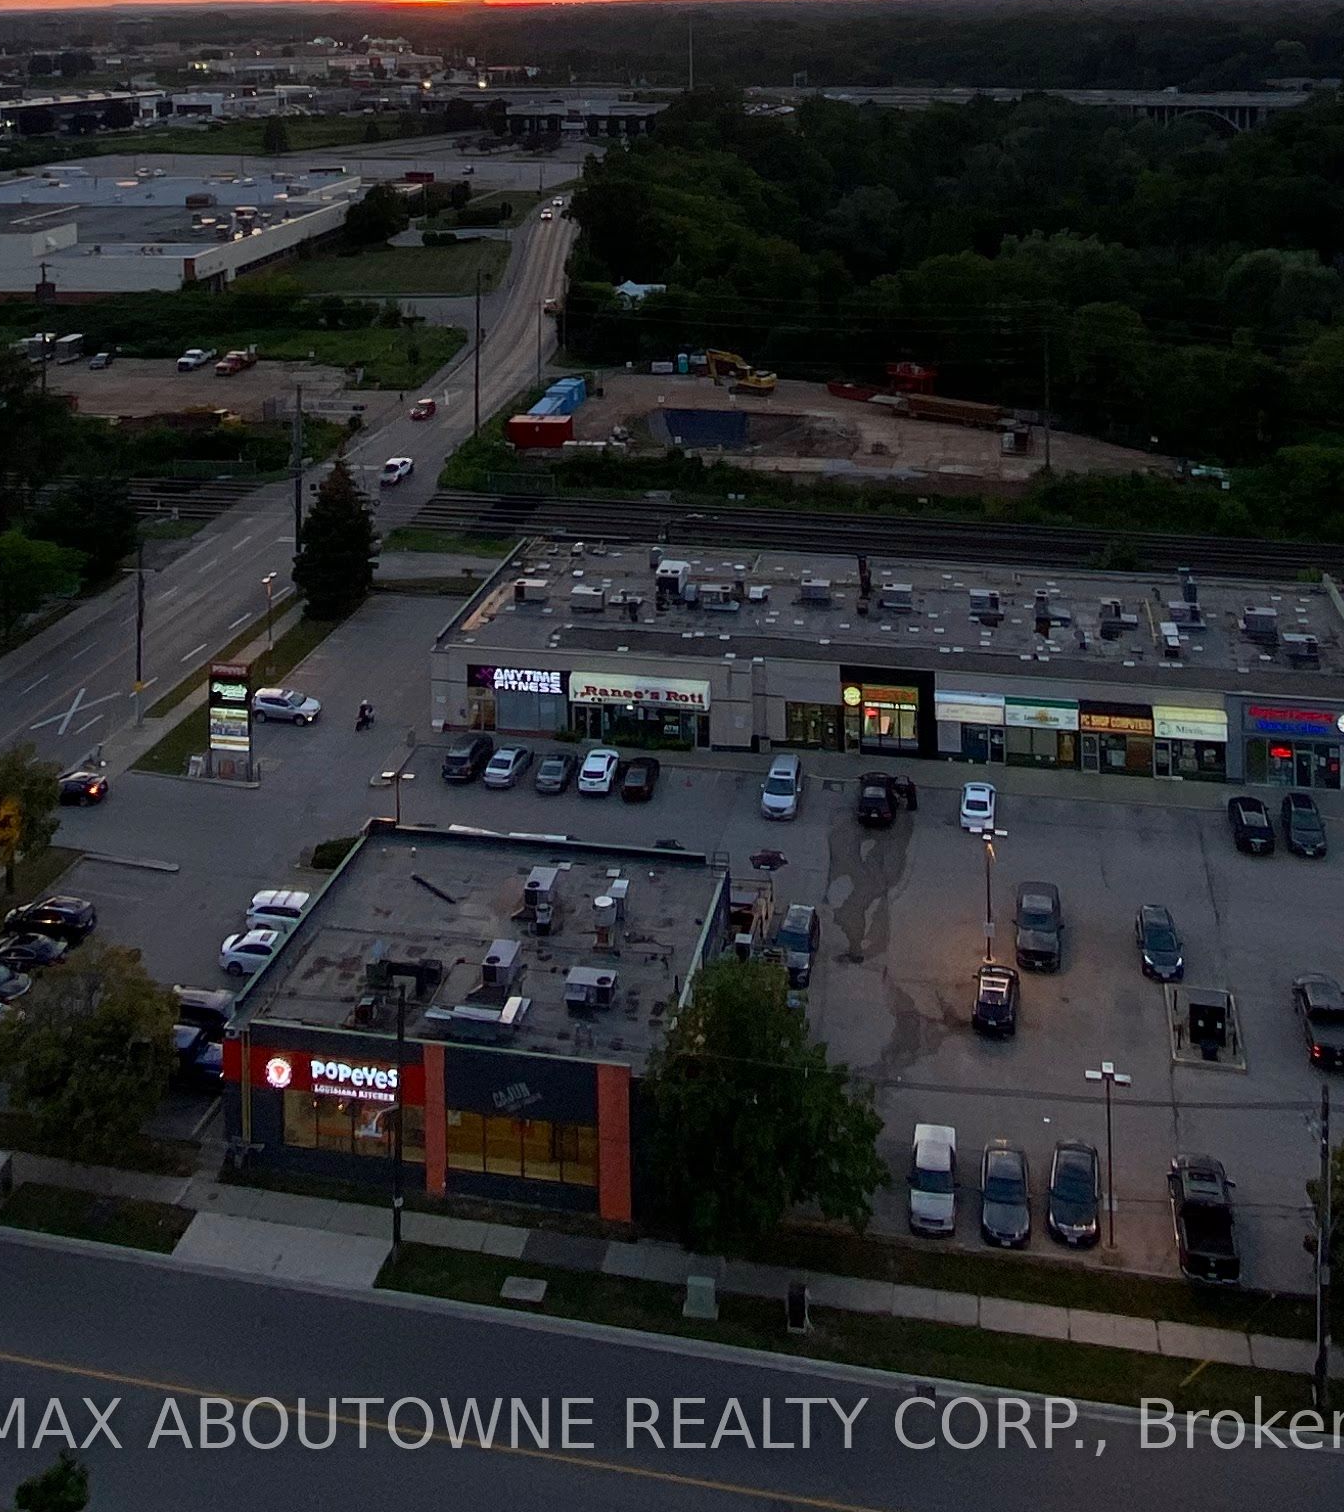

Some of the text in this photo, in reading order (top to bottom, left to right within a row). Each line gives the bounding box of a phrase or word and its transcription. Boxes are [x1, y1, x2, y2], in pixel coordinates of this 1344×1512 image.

[493, 668, 561, 683] ANYTIME
[583, 685, 705, 704] Ranee's Roti
